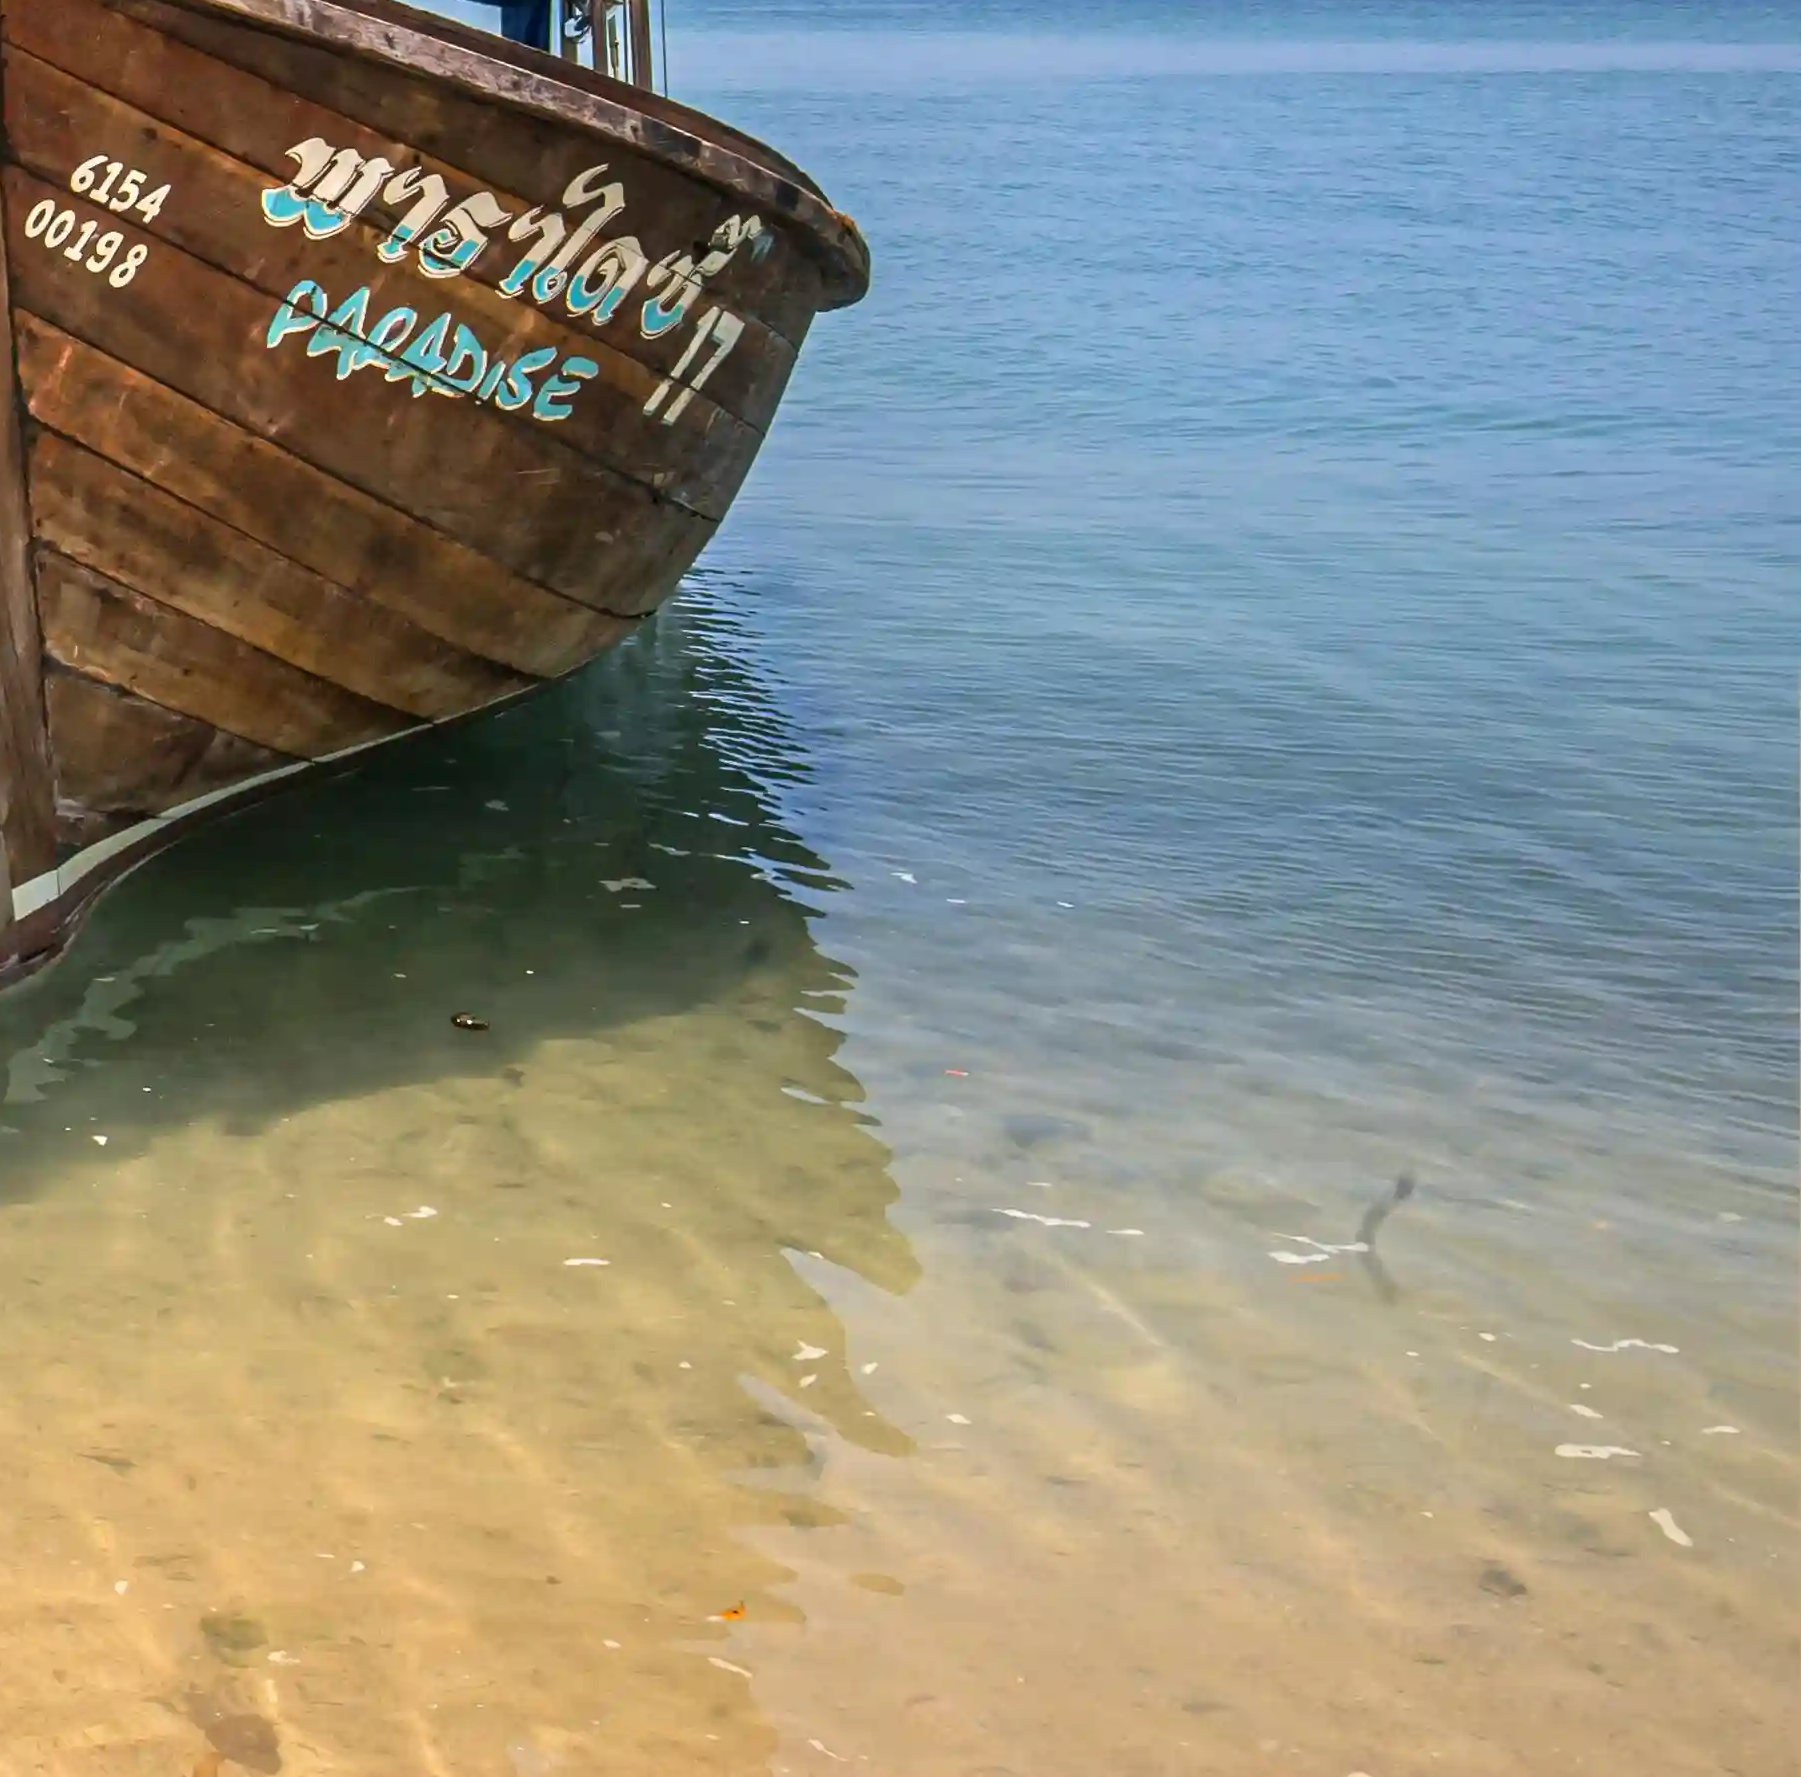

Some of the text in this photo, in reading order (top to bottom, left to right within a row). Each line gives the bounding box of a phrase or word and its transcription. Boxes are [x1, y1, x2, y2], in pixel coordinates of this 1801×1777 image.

[70, 154, 172, 225] 6154
[24, 198, 149, 289] 00198
[266, 278, 600, 422] PARADISE
[642, 305, 746, 427] 17
